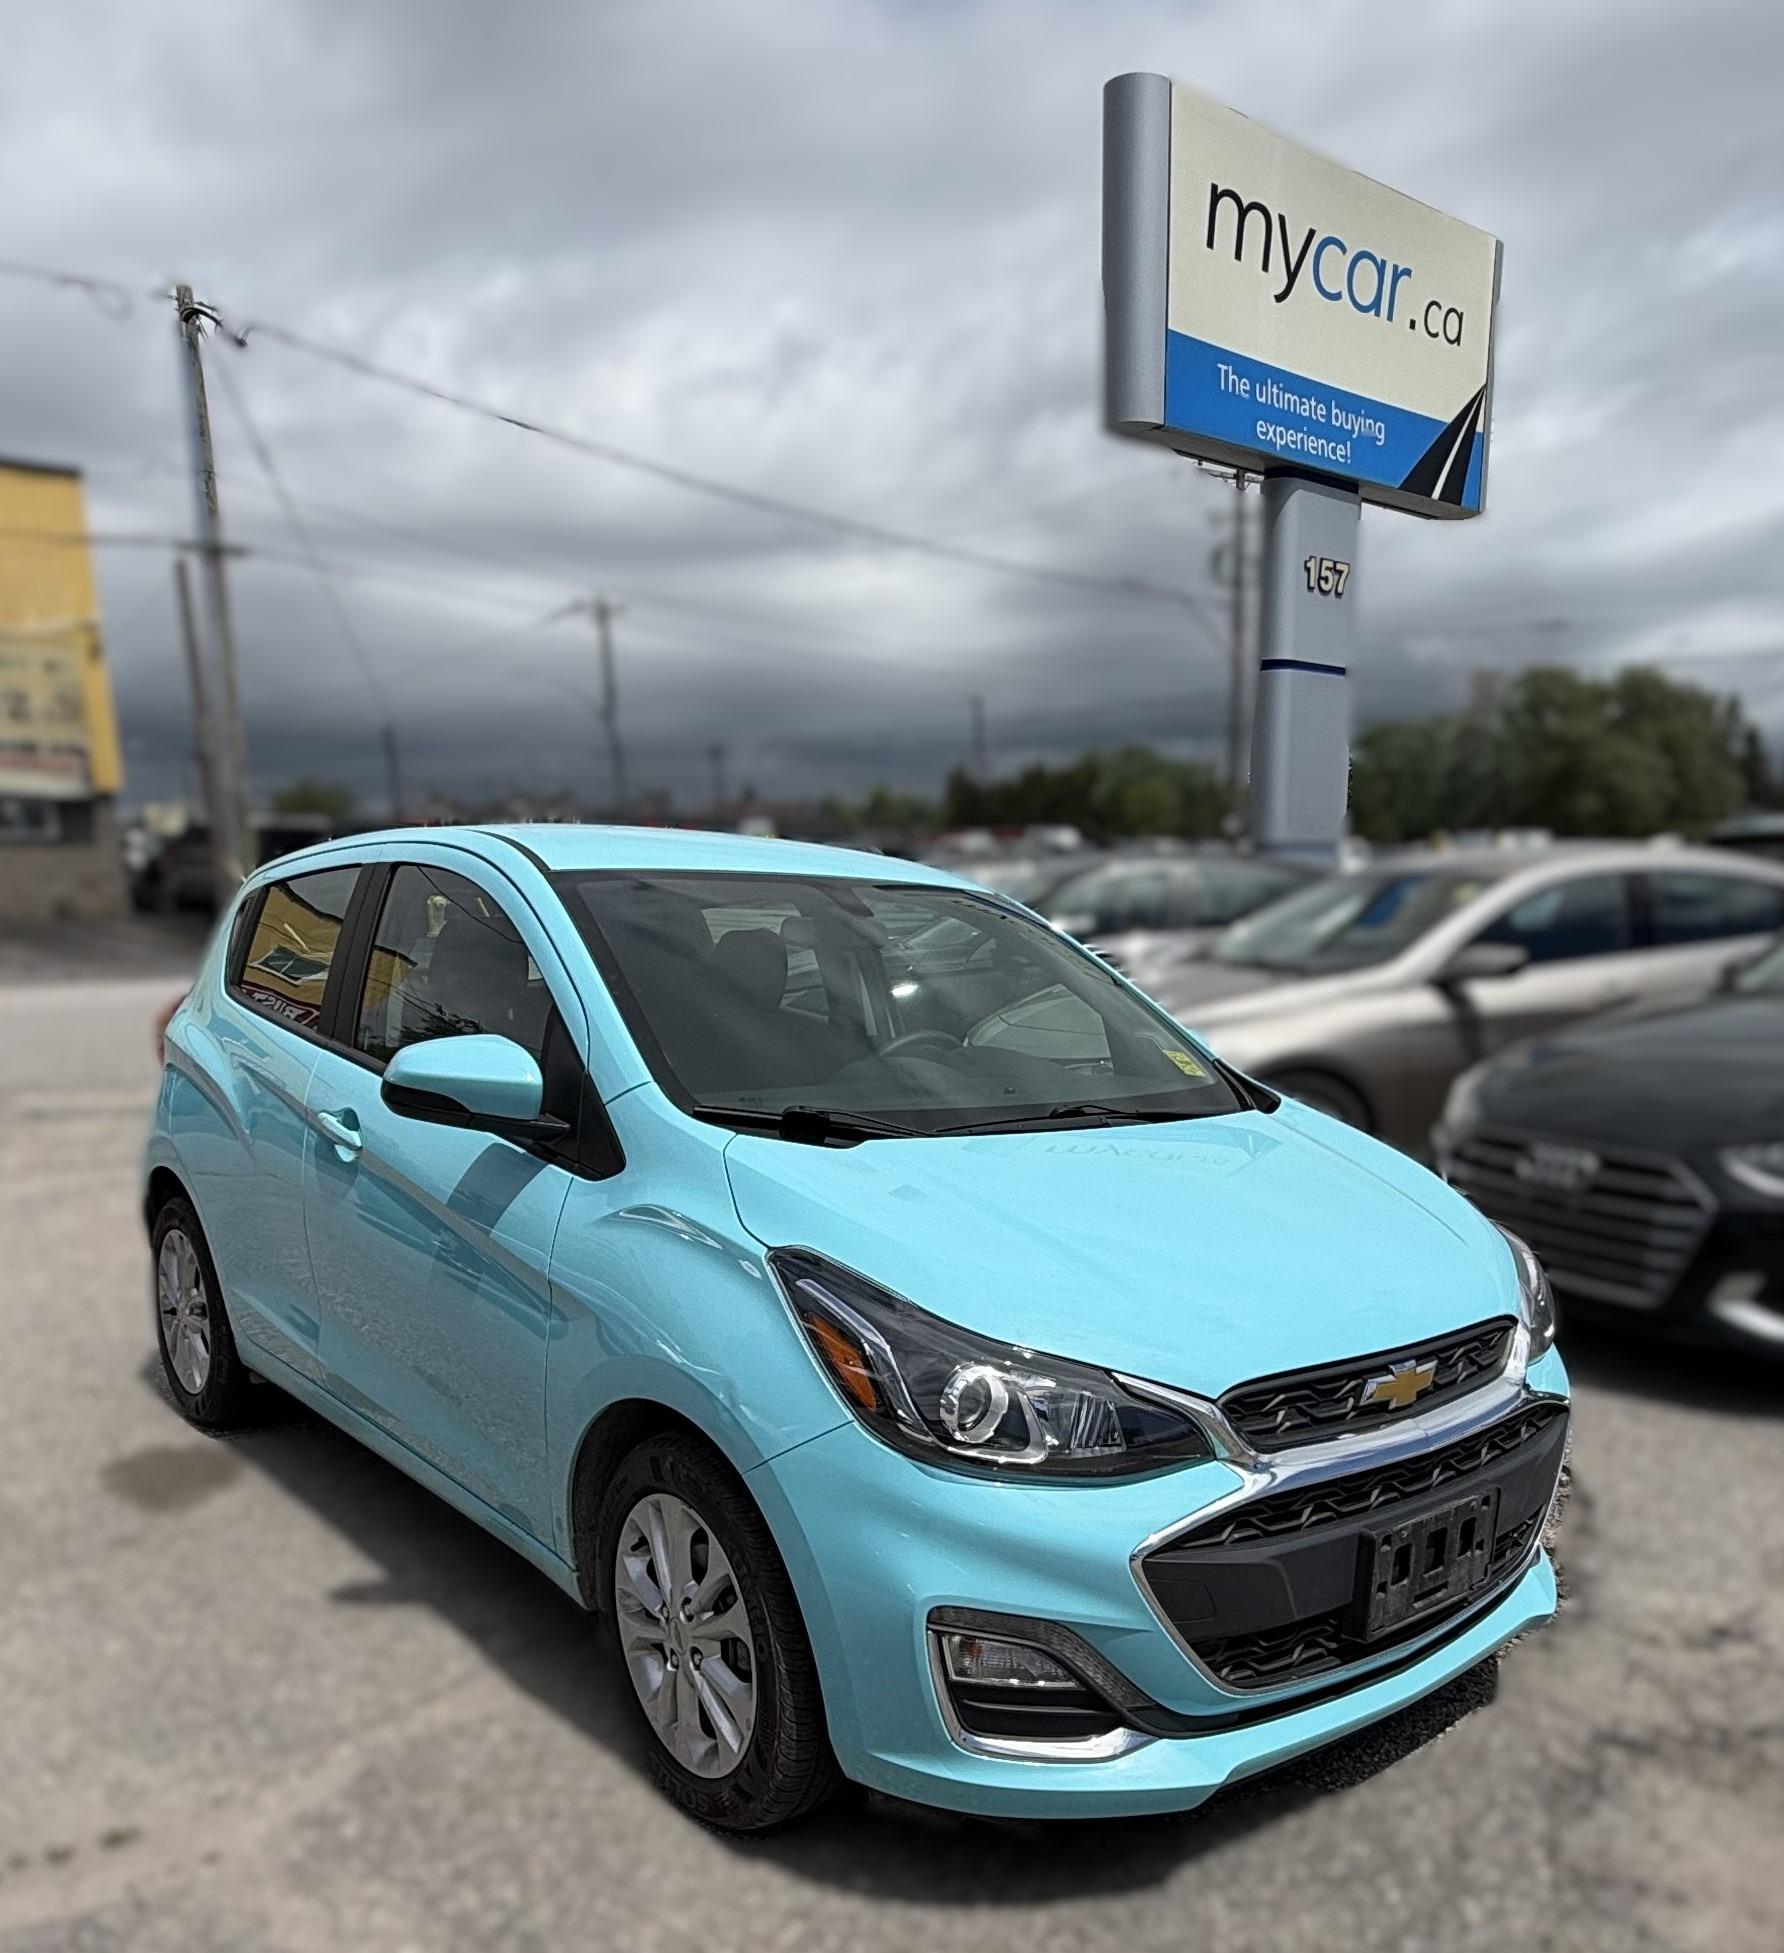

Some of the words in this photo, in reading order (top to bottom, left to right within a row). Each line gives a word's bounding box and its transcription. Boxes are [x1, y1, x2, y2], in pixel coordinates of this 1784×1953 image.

[1206, 181, 1464, 347] mycar.ca
[1216, 363, 1250, 399] The
[1255, 378, 1327, 423] ultimate
[1331, 400, 1386, 447] buying
[1256, 419, 1352, 465] experience!
[1303, 554, 1351, 599] 157
